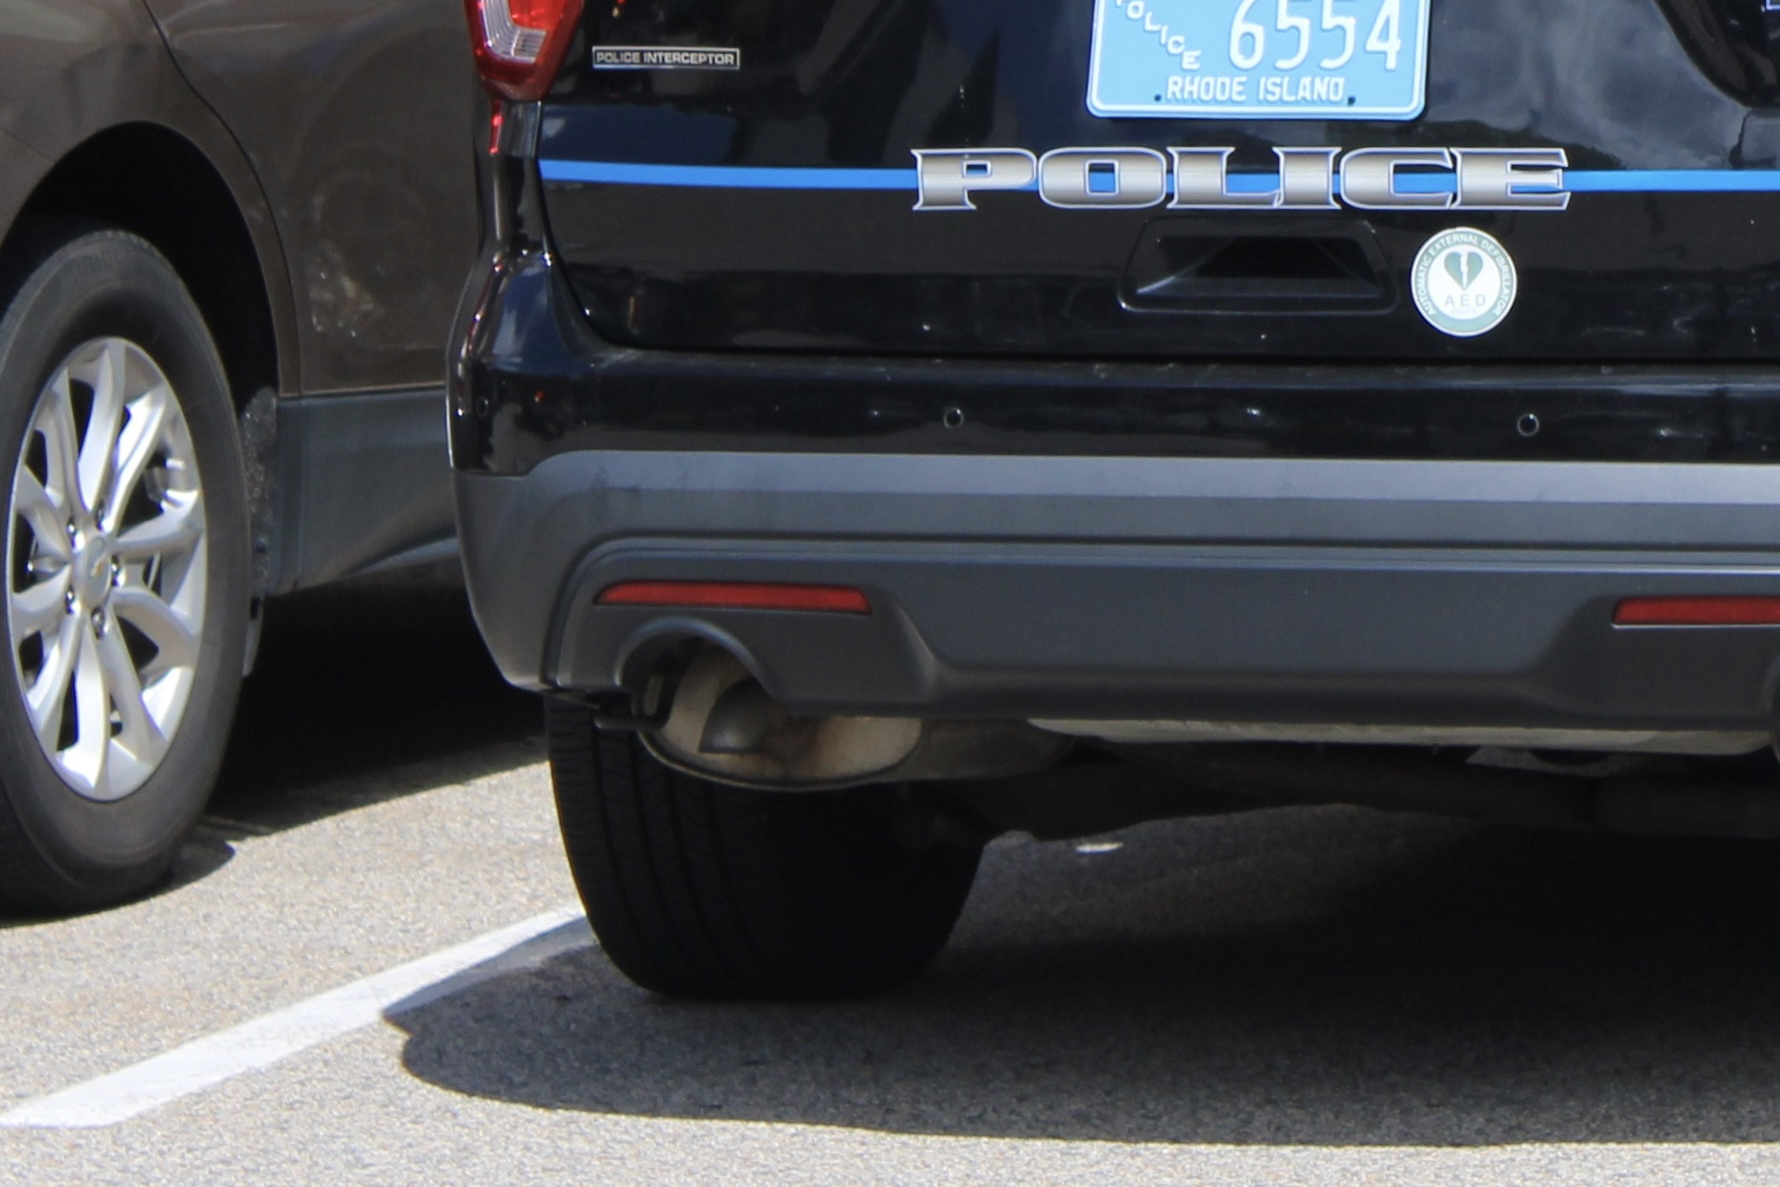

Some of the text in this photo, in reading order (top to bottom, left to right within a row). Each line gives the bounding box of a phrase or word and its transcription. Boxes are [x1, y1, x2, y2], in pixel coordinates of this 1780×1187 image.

[596, 51, 735, 65] POLICE INTERCEPTOR
[1166, 75, 1346, 102] RHODE ISLAND
[911, 146, 1571, 211] POLICE
[1416, 233, 1512, 316] AUTOMATIC EXTERNAL DEFIBRILLATOR
[1444, 293, 1487, 308] AED
